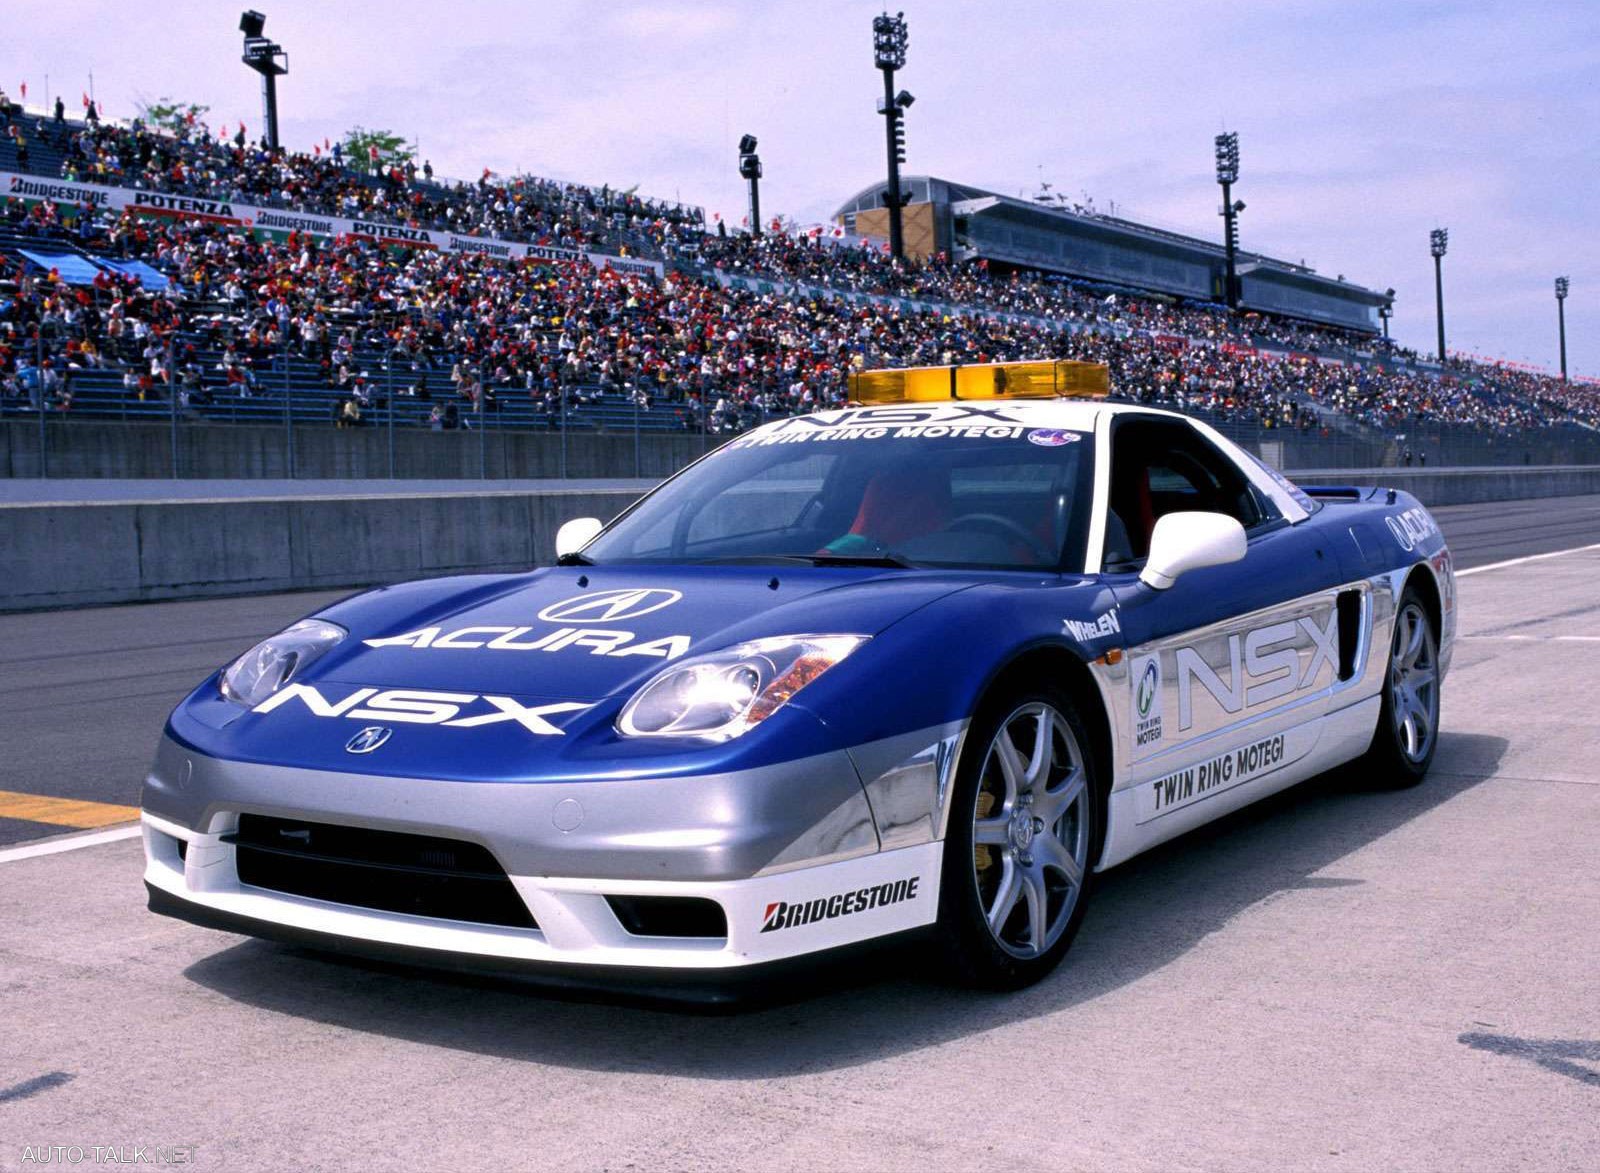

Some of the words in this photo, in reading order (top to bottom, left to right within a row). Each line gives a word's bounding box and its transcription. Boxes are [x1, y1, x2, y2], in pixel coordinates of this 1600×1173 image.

[10, 176, 109, 205] BRIDGESTONE
[134, 192, 234, 217] POTENZA
[255, 210, 333, 234] BRIDGESTONE
[353, 222, 431, 243] POTENZA
[770, 405, 1024, 433] NSX
[812, 427, 889, 442] RING
[895, 425, 1025, 443] MOTEGI
[1063, 608, 1121, 642] WHELEN
[361, 626, 692, 661] ACURA
[1177, 607, 1340, 732] NSX
[252, 682, 598, 736] NSX
[1136, 726, 1162, 746] MOTEGI
[1153, 769, 1193, 810] TWIN
[1197, 757, 1233, 793] RING
[1235, 734, 1285, 777] MOTEGI
[760, 876, 920, 933] BRIDGESTONE
